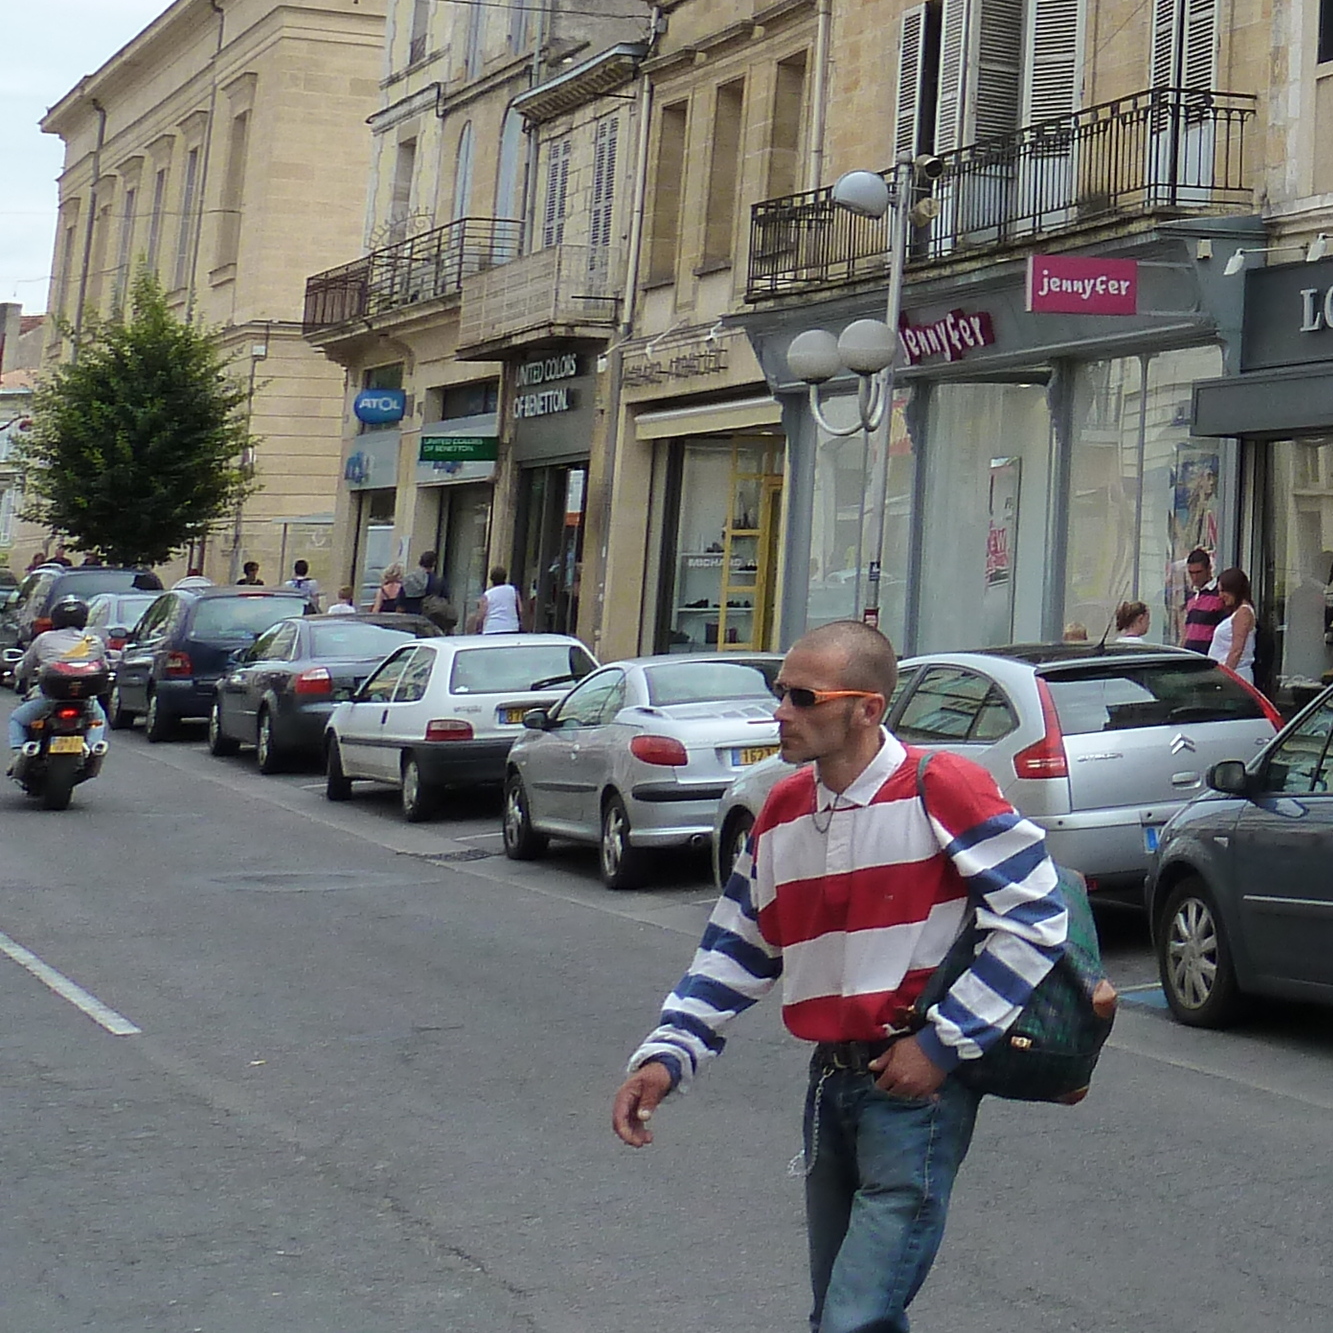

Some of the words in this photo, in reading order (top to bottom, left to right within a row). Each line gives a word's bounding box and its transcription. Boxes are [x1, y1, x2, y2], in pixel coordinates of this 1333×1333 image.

[1038, 270, 1131, 300] jennyfer
[899, 314, 986, 366] jennyfer
[359, 397, 401, 411] ATOL
